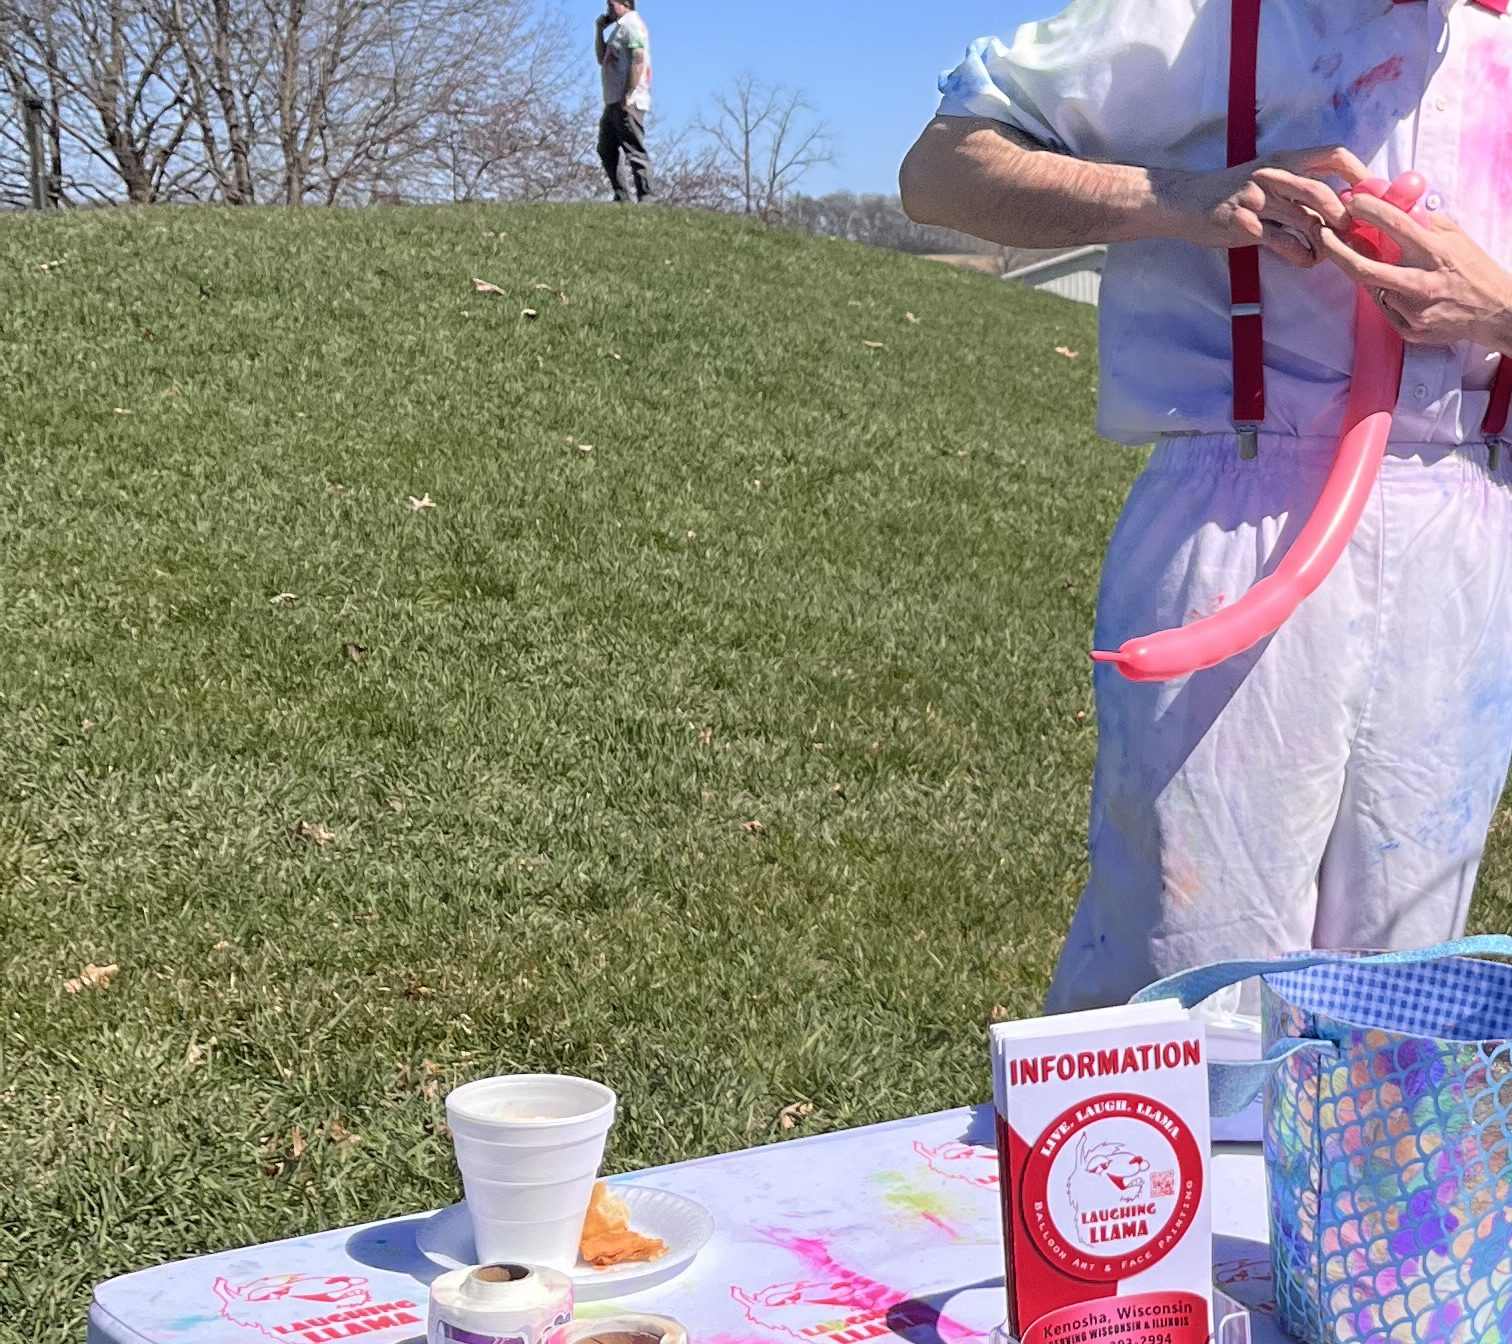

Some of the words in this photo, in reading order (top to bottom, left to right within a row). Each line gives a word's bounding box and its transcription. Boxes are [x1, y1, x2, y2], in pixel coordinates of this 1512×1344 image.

[1009, 1039, 1201, 1086] INFORMATION
[1040, 1120, 1074, 1157] LIVE.
[1075, 1099, 1132, 1122] LAUGH.
[1034, 1201, 1067, 1260] BALLOON
[1072, 1258, 1096, 1272] ART
[1104, 1264, 1112, 1273] &
[1121, 1251, 1153, 1270] FACE
[1158, 1179, 1193, 1249] PAINTING
[1081, 1203, 1156, 1225] LAUGHING
[1090, 1219, 1149, 1244] LLAMA
[272, 1299, 417, 1334] LAUGHING
[302, 1312, 423, 1343] LLAMA
[1044, 1312, 1111, 1339] Kenosha,
[1116, 1300, 1193, 1320] Wisconsin
[1090, 1321, 1141, 1339] WISCONSIN
[1143, 1321, 1151, 1329] &
[1152, 1317, 1190, 1329] ILLINOIS
